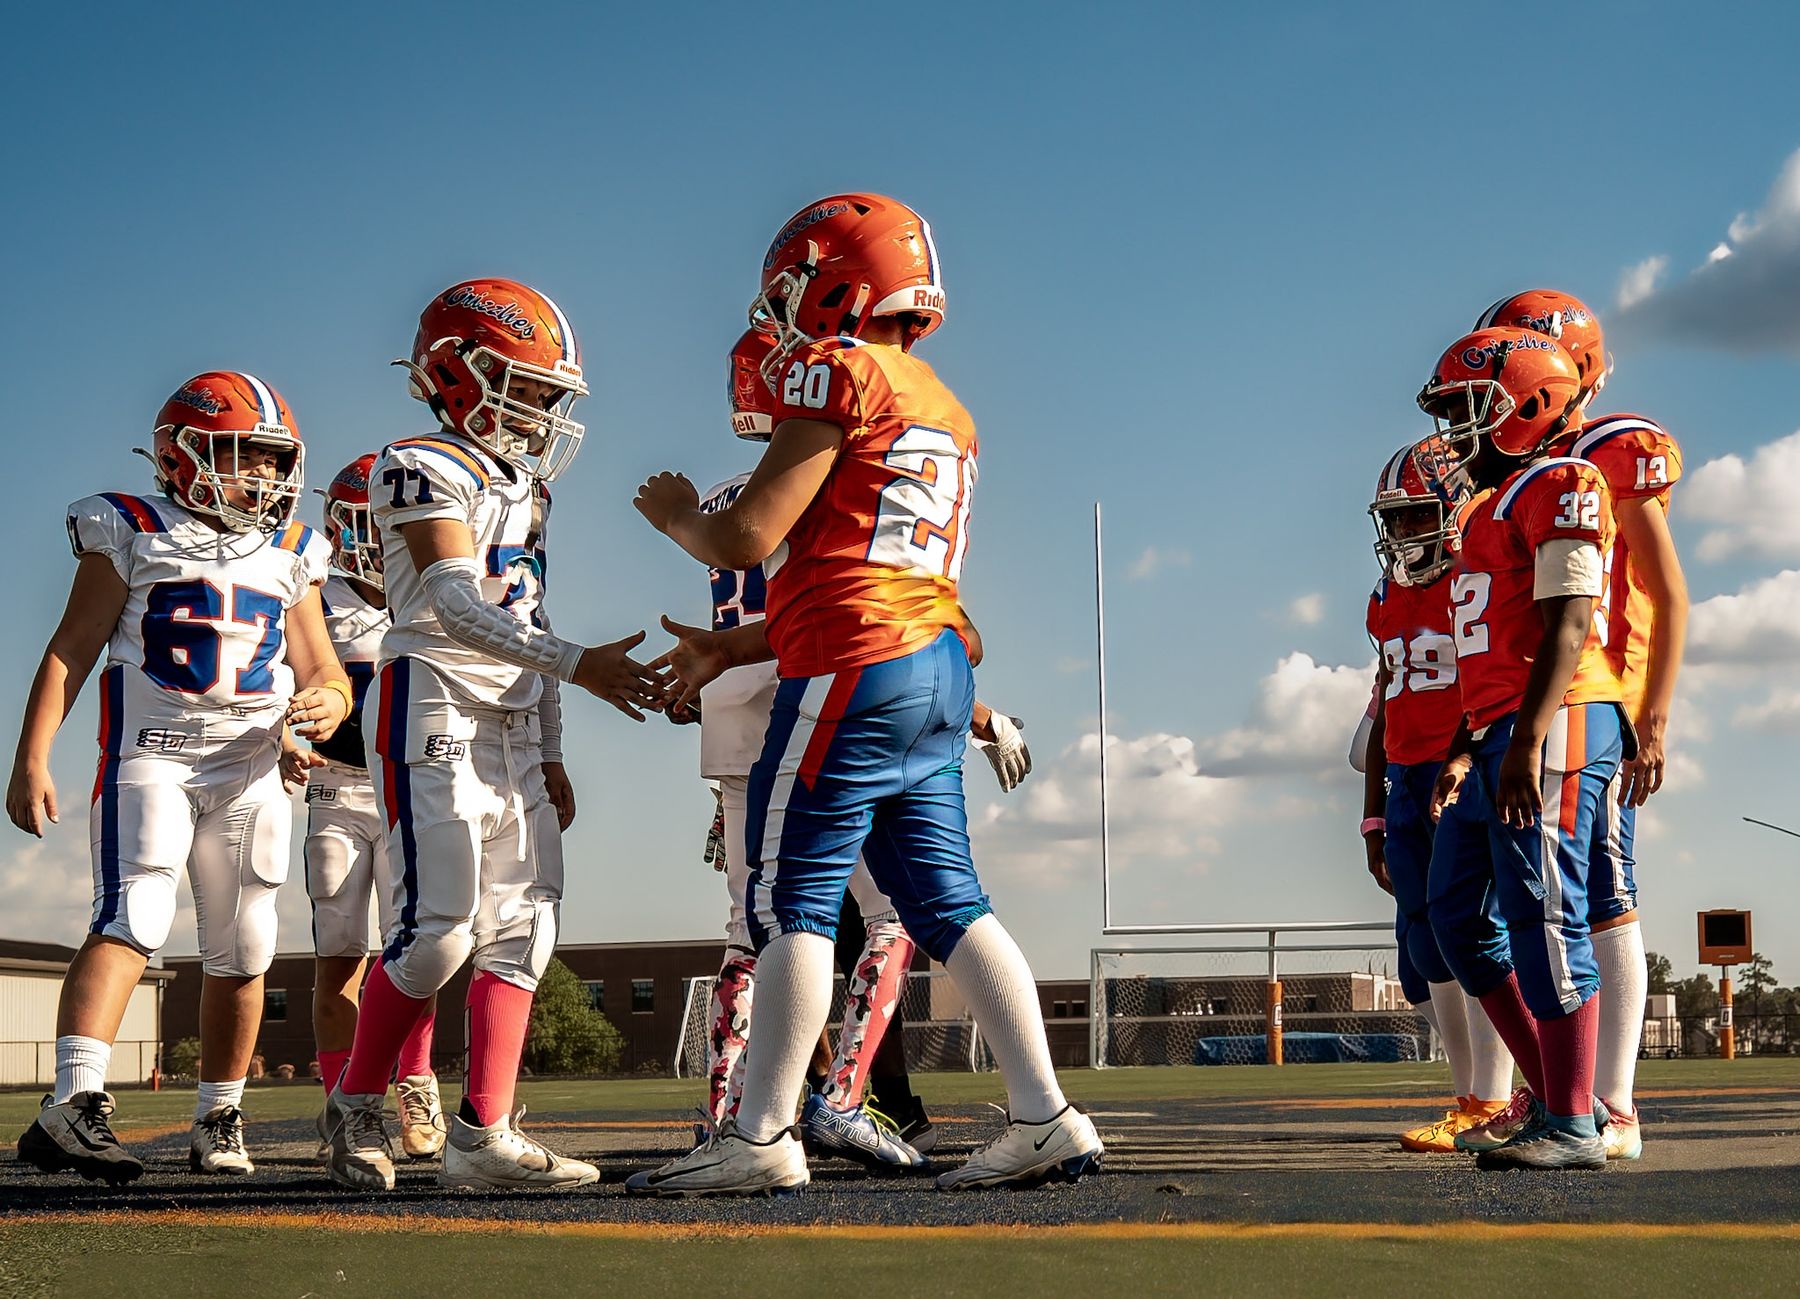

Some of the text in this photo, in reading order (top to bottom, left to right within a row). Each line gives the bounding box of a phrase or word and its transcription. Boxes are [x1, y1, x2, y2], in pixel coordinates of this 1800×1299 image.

[447, 285, 537, 339] Grizzlies
[783, 360, 832, 409] 20
[382, 466, 435, 509] 77
[1633, 455, 1668, 491] 13
[1554, 490, 1601, 531] 32
[141, 580, 284, 696] 67
[1447, 572, 1491, 659] 2
